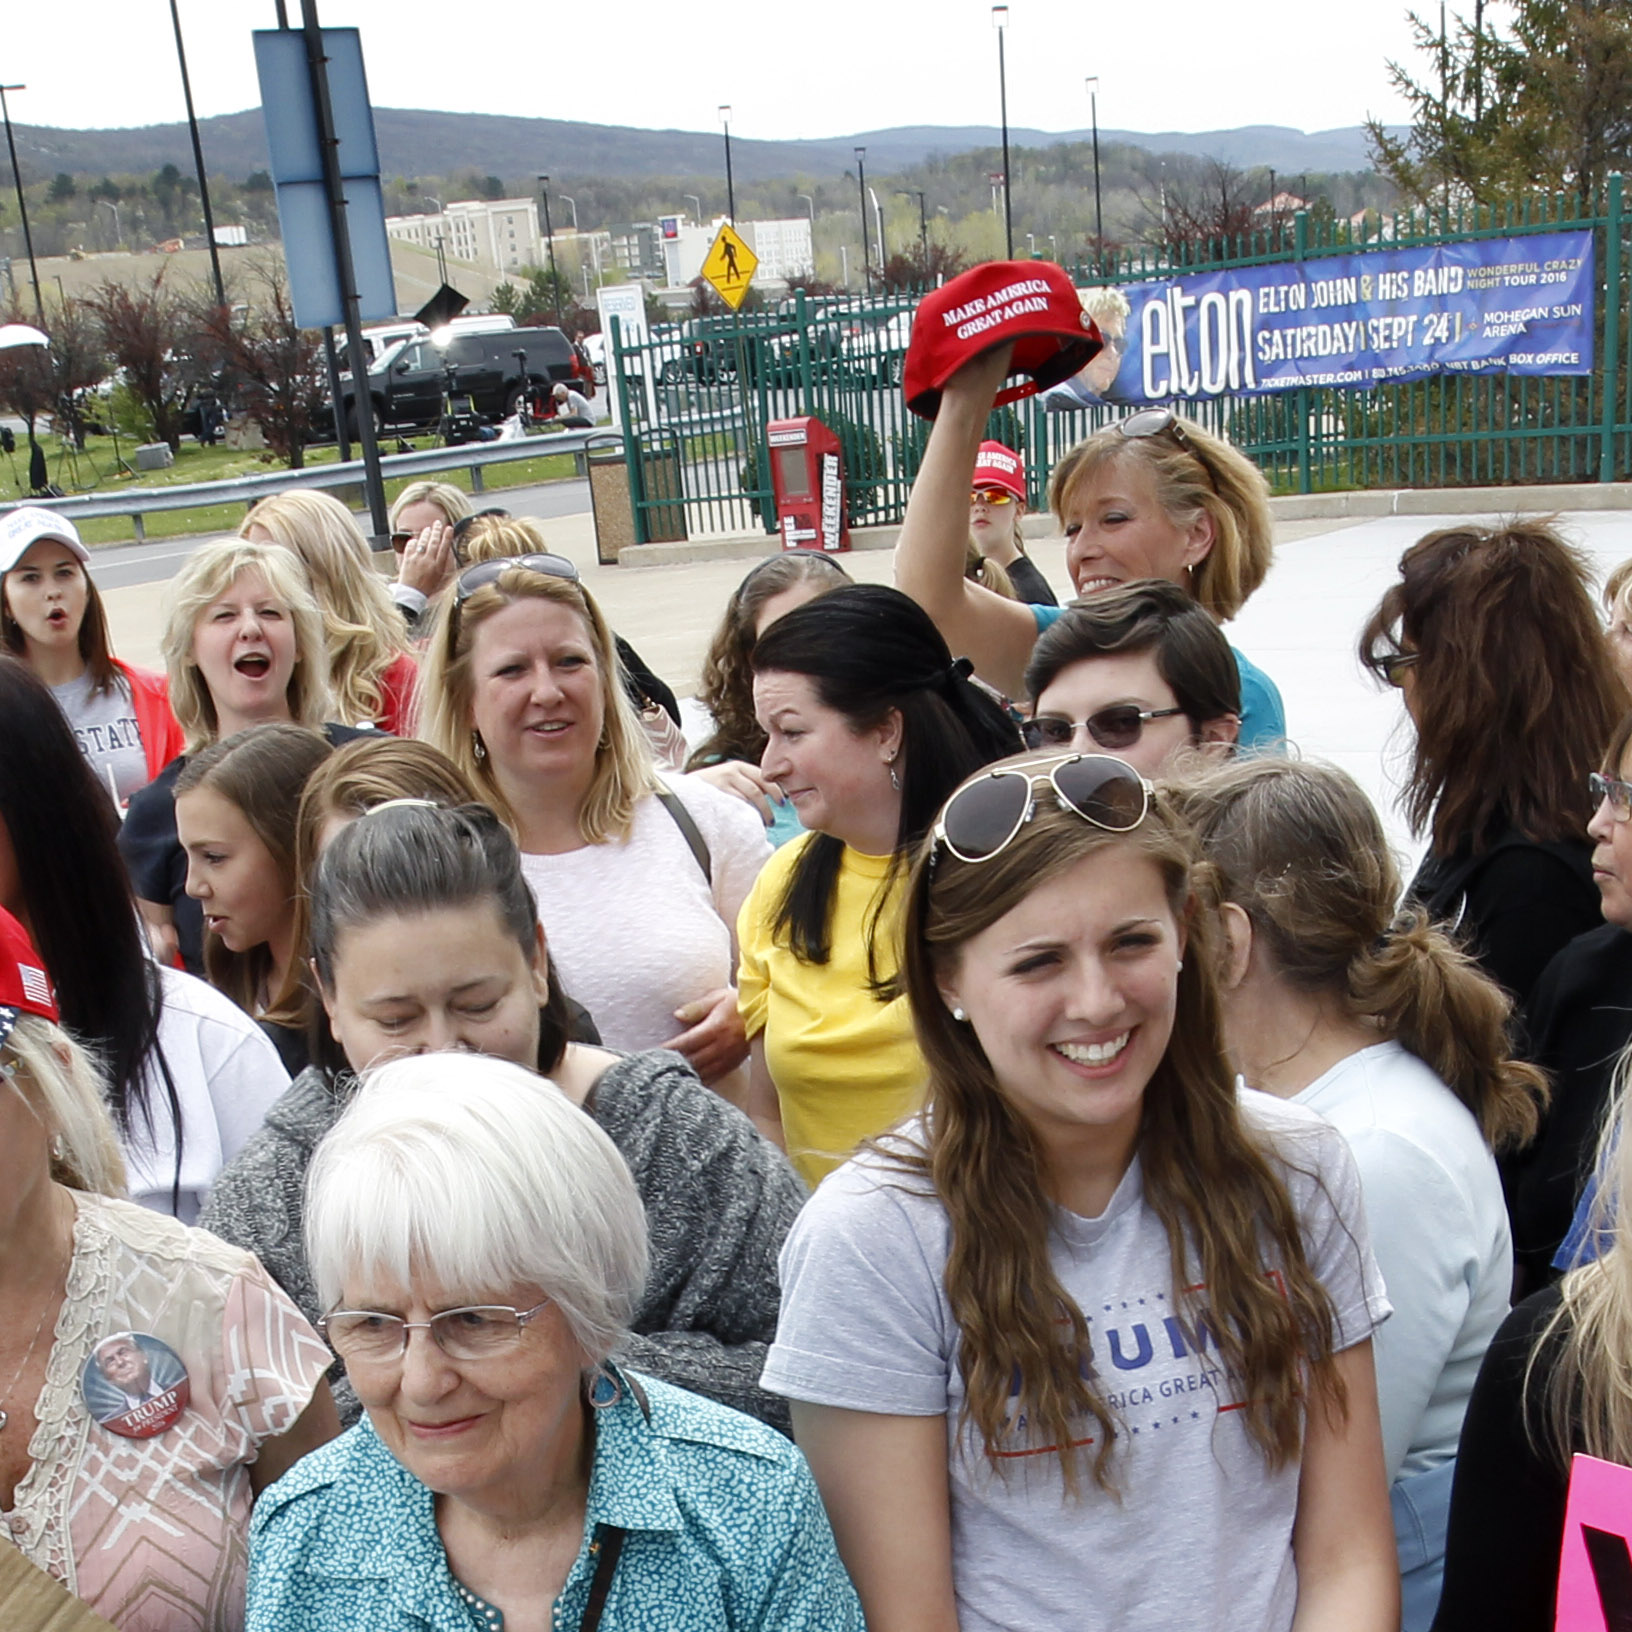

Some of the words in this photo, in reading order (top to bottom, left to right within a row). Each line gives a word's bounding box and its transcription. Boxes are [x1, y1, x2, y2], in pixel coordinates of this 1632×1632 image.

[1467, 262, 1540, 278] WONDERFUL
[1467, 276, 1501, 290] NIGHT
[1504, 273, 1536, 287] TOUR
[1540, 271, 1567, 284] 2016
[942, 298, 988, 327] MAKE
[983, 280, 1052, 309] AMERICA
[1259, 282, 1306, 314] ELTON
[1311, 276, 1357, 308] JOHN
[1361, 275, 1373, 301] &
[1378, 271, 1409, 300] HIS
[1414, 266, 1464, 297] BAND
[957, 311, 1005, 340] GREAT
[1004, 297, 1049, 320] AGAIN
[1368, 314, 1417, 350] SEPT
[1423, 312, 1450, 346] 24
[1482, 322, 1528, 338] ARENA
[1483, 305, 1549, 324] MOHEGAN
[1552, 304, 1583, 317] SUN
[1142, 286, 1256, 399] elton
[1261, 370, 1362, 389] TICKETMASTER.COM
[1471, 355, 1507, 370] BANK
[1509, 353, 1534, 364] BOX
[1536, 352, 1580, 365] OFFICE
[822, 453, 838, 549] WEEKENDER
[1159, 1368, 1220, 1398] GREAT
[121, 1391, 179, 1428] TRUMP
[141, 1404, 180, 1428] PRESIDENT
